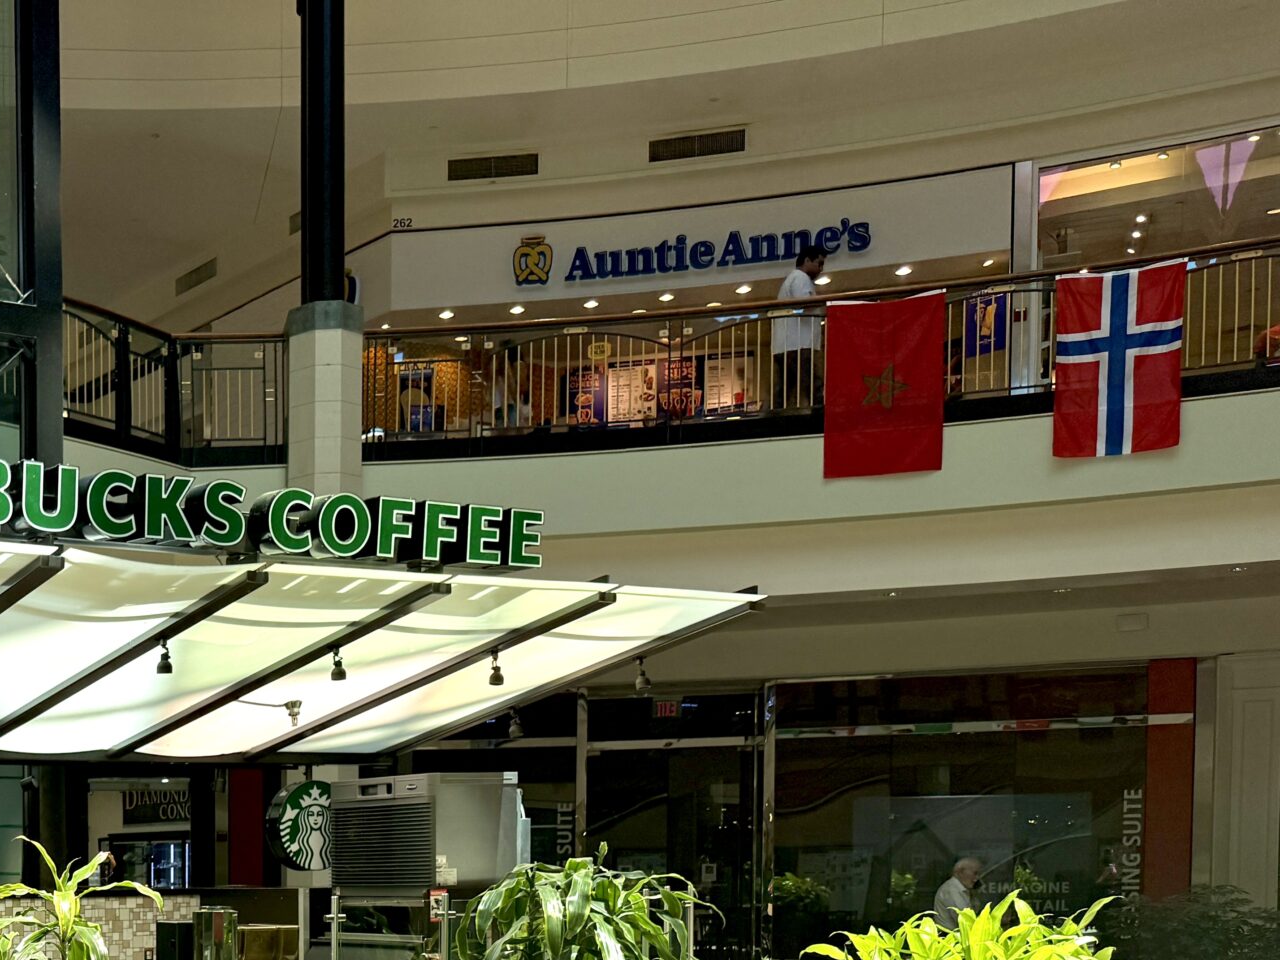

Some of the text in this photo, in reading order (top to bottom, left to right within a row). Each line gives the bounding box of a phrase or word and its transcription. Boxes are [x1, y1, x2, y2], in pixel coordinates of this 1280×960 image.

[392, 217, 413, 229] 262
[564, 217, 871, 282] Auntie Anne's
[267, 487, 545, 568] COFFEE
[556, 803, 573, 855] SUITE
[1122, 788, 1143, 848] SUITE
